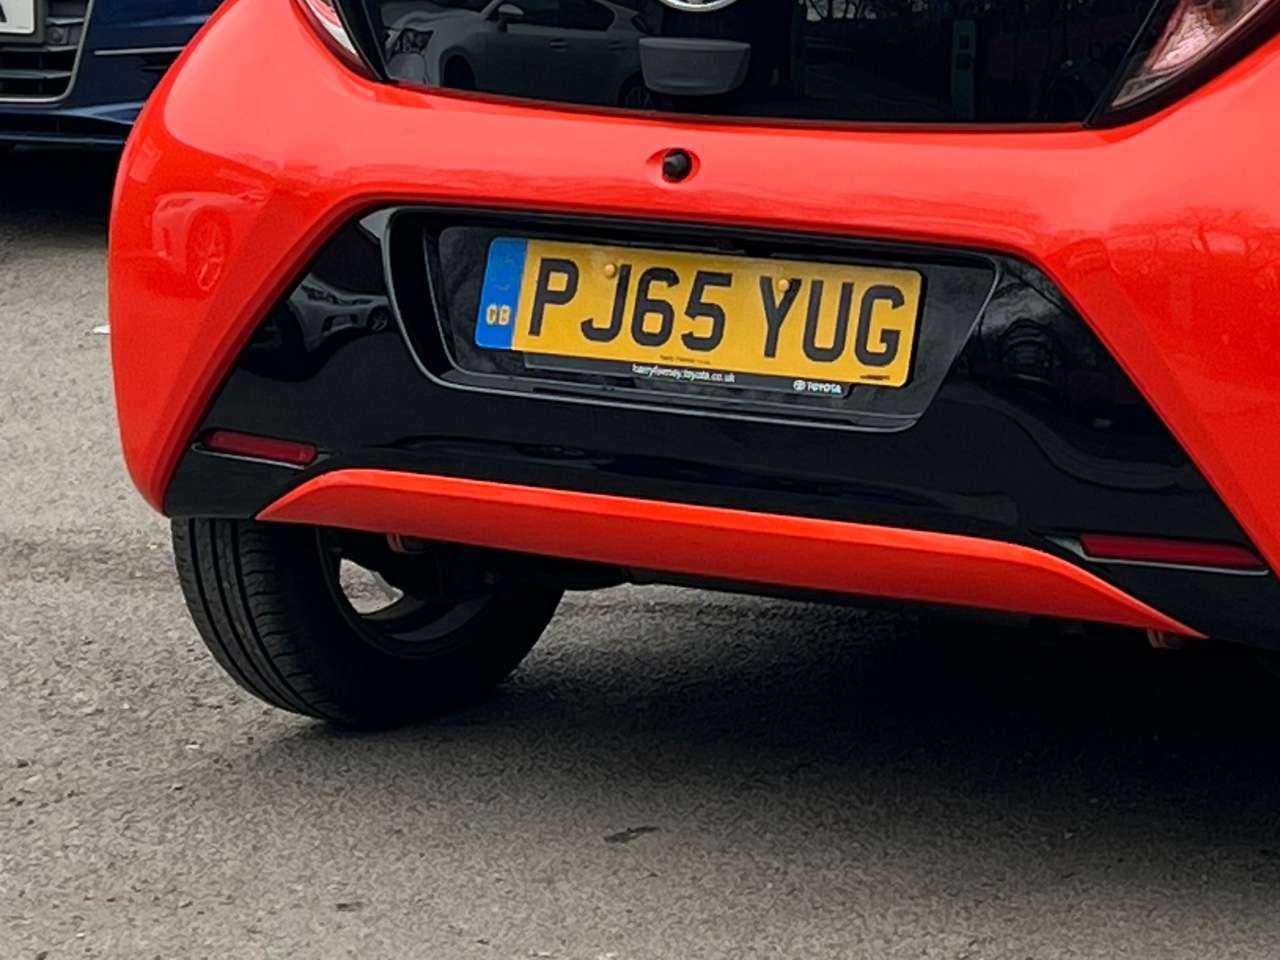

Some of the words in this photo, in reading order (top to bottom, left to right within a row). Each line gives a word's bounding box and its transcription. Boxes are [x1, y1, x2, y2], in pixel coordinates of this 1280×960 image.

[486, 303, 511, 326] GB
[527, 256, 733, 352] PJ65
[759, 275, 905, 367] YUG
[807, 380, 843, 395] TOYOTA
